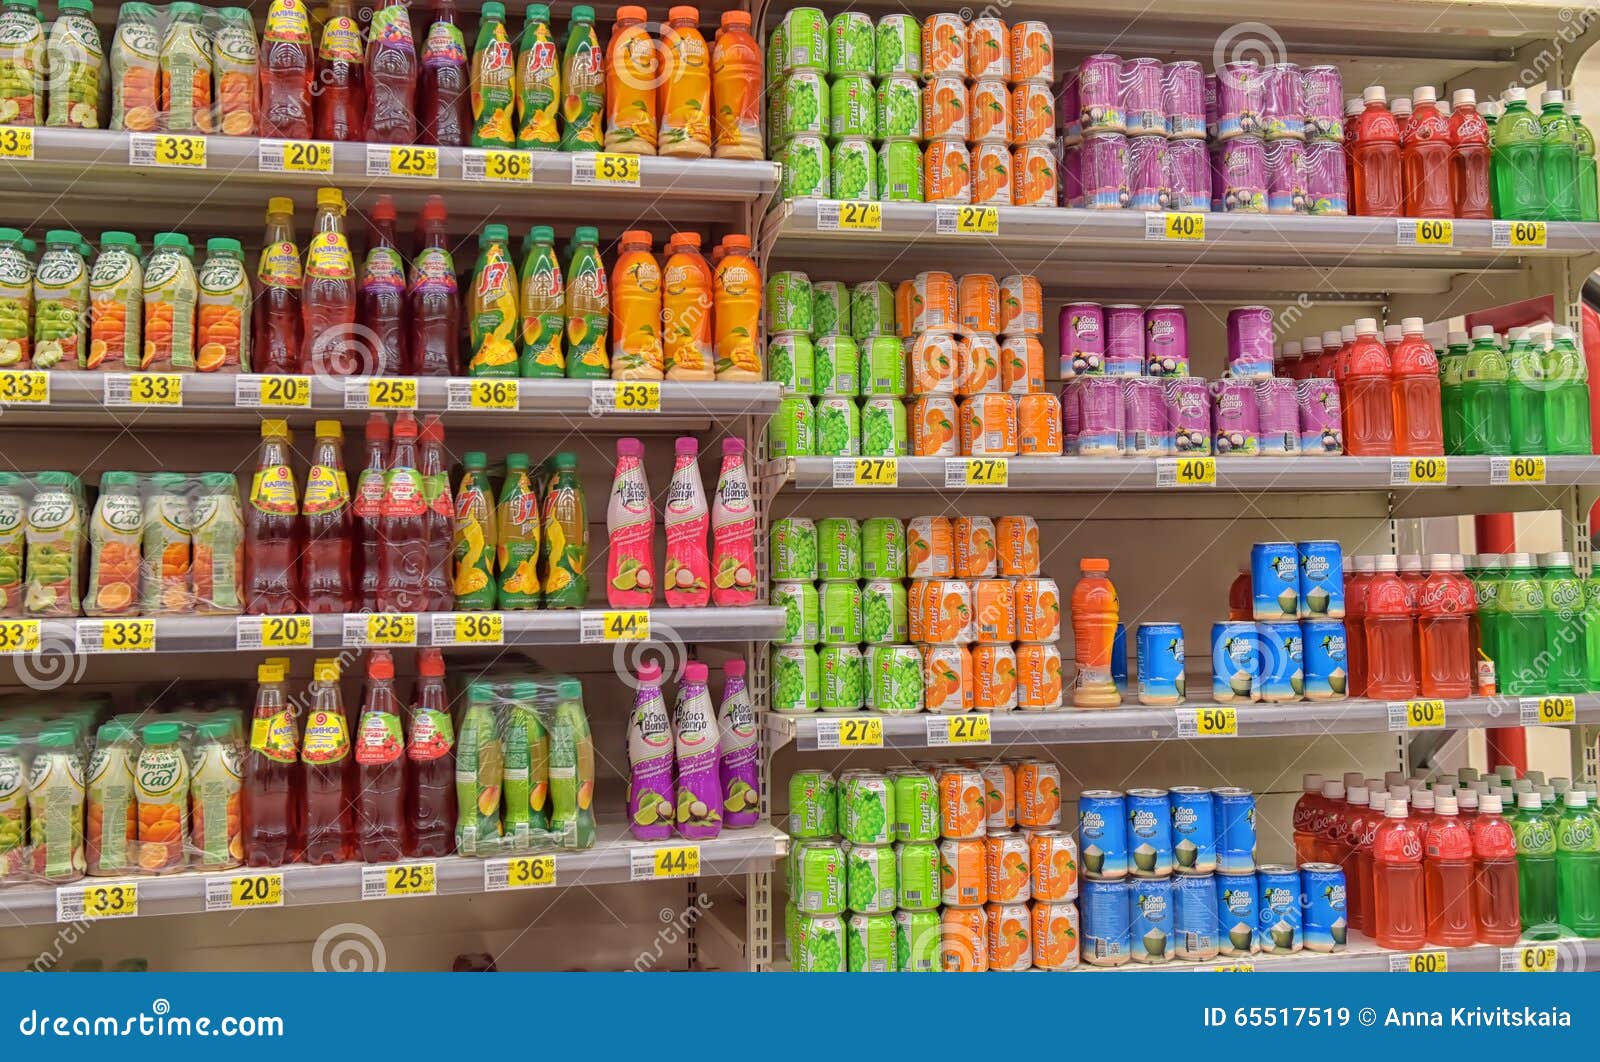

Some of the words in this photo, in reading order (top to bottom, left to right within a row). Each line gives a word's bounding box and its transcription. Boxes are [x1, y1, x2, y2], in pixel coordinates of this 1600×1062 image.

[0, 130, 18, 151] 3
[165, 138, 193, 161] 33
[291, 144, 319, 165] 20
[397, 150, 425, 171] 25
[494, 155, 520, 176] 36
[602, 158, 628, 178] 53
[845, 204, 869, 223] 27
[963, 208, 987, 227] 27
[1171, 216, 1194, 235] 40
[1421, 222, 1443, 240] 60
[1516, 224, 1537, 241] 60
[1418, 353, 1437, 367] alo
[3, 375, 33, 397] 33
[140, 377, 169, 399] 33
[268, 379, 297, 400] 20
[375, 381, 404, 403] 25
[479, 383, 506, 403] 36
[623, 386, 649, 407] 53
[861, 460, 885, 480] 27
[972, 461, 996, 480] 27
[1181, 461, 1205, 480] 40
[1415, 461, 1437, 479] 60
[1514, 459, 1535, 477] 60
[1475, 586, 1497, 605] loe
[1552, 585, 1580, 605] aloe
[112, 623, 142, 646] 33
[270, 619, 299, 640] 20
[375, 617, 403, 638] 25
[463, 616, 491, 637] 36
[611, 615, 637, 636] 44
[0, 625, 24, 647] 33
[1412, 704, 1434, 722] 60
[1543, 699, 1565, 717] 60
[954, 717, 977, 737] 27
[1202, 711, 1225, 730] 50
[845, 721, 869, 741] 27
[1562, 824, 1592, 847] aloe
[517, 860, 544, 881] 36
[660, 851, 688, 872] 44
[394, 867, 423, 889] 25
[95, 887, 125, 911] 33
[239, 878, 269, 901] 20
[1415, 955, 1437, 972] 60
[1524, 949, 1547, 968] 60
